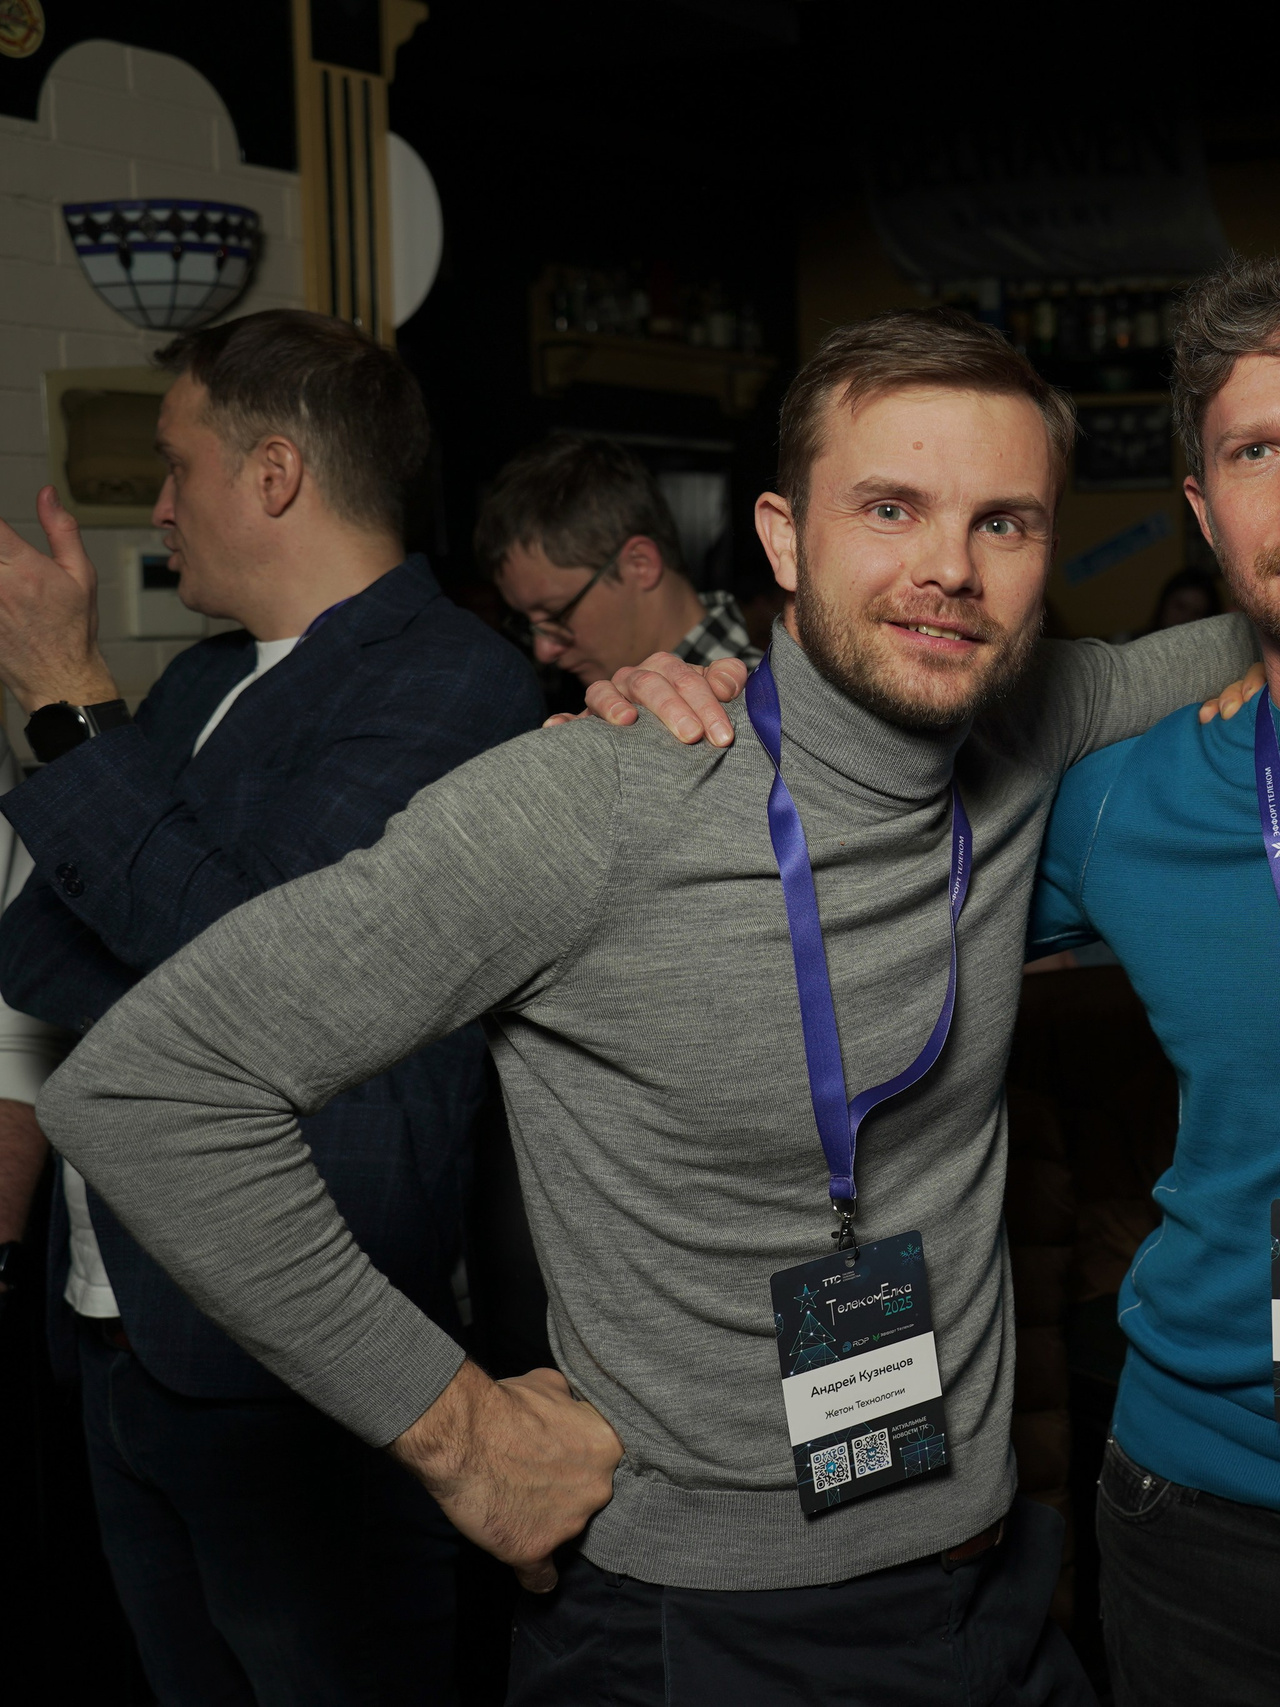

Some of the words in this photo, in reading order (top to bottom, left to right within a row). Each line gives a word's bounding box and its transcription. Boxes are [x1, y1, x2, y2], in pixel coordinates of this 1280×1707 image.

[1264, 767, 1275, 802] ТЕЛЕКОМ
[1269, 804, 1280, 837] ЭФФОРТ
[957, 835, 965, 874] ТЕЛЕКОМ
[884, 1295, 913, 1316] 2025
[810, 1372, 857, 1398] Андрей
[859, 1357, 914, 1383] Кузнецов
[825, 1403, 854, 1420] Жетон
[855, 1387, 906, 1408] Технологии
[892, 1427, 918, 1440] НОВОСТИ
